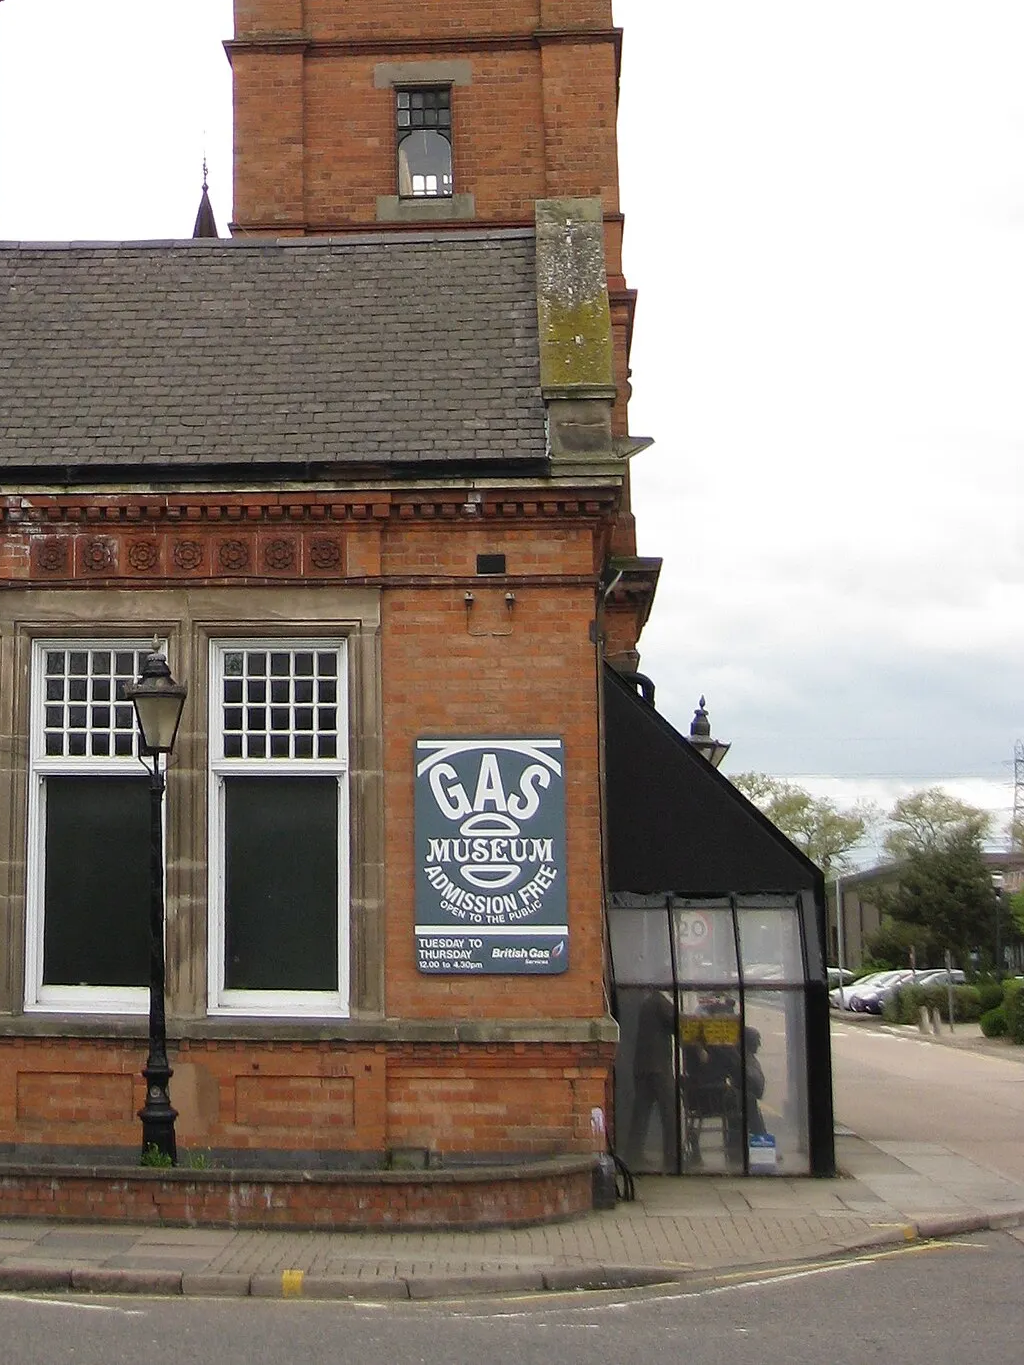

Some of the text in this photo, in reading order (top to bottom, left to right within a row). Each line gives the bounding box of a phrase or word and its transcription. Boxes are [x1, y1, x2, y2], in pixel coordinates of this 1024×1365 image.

[429, 753, 551, 821] GAS
[426, 837, 554, 863] MUSEUM
[423, 864, 557, 914] ADMISSION FREE
[440, 899, 543, 924] OPEN TO THE PUBLIC
[419, 938, 483, 948] TUESDAY TO
[419, 949, 472, 959] THURSDAY
[492, 948, 550, 959] British Gas
[419, 961, 483, 970] 12.00 to 4.30pm
